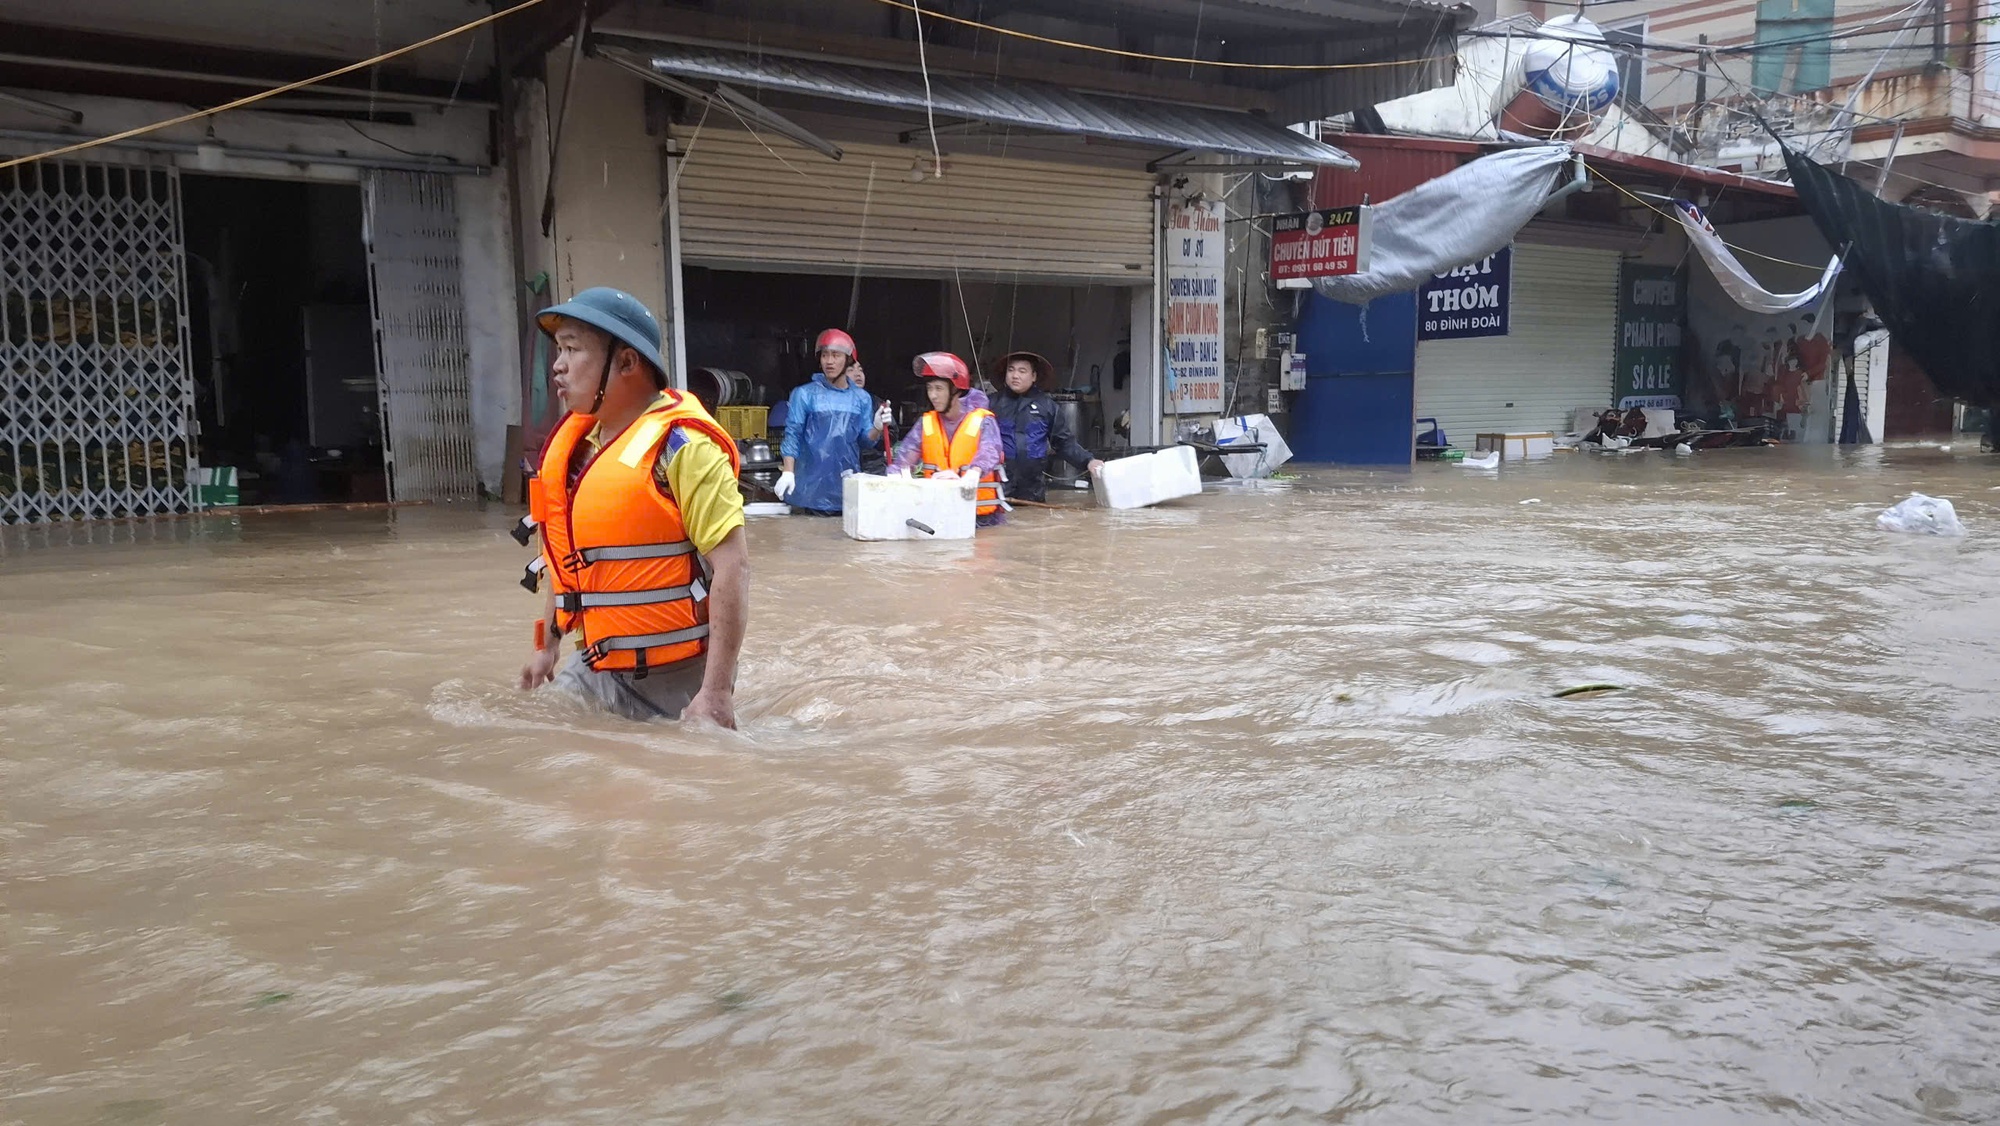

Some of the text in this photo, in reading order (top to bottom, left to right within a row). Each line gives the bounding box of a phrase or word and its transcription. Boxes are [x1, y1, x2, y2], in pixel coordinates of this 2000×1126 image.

[1276, 211, 1353, 231] NHẬN 24/7
[1273, 229, 1355, 262] CHUYỂN RÚT TIỀN
[1292, 263, 1311, 273] 0931
[1434, 253, 1496, 282] IẠT
[1191, 271, 1203, 296] SẢN
[1633, 275, 1676, 306] CHUYÊN
[1427, 282, 1500, 313] THƠM
[1425, 312, 1500, 331] 80 ĐÌNH ĐOÀI
[1624, 316, 1654, 348] PHÂN
[1200, 337, 1211, 362] BÁN
[1189, 364, 1203, 378] ĐÌNH
[1632, 355, 1644, 390] SỈ
[1647, 364, 1655, 389] &
